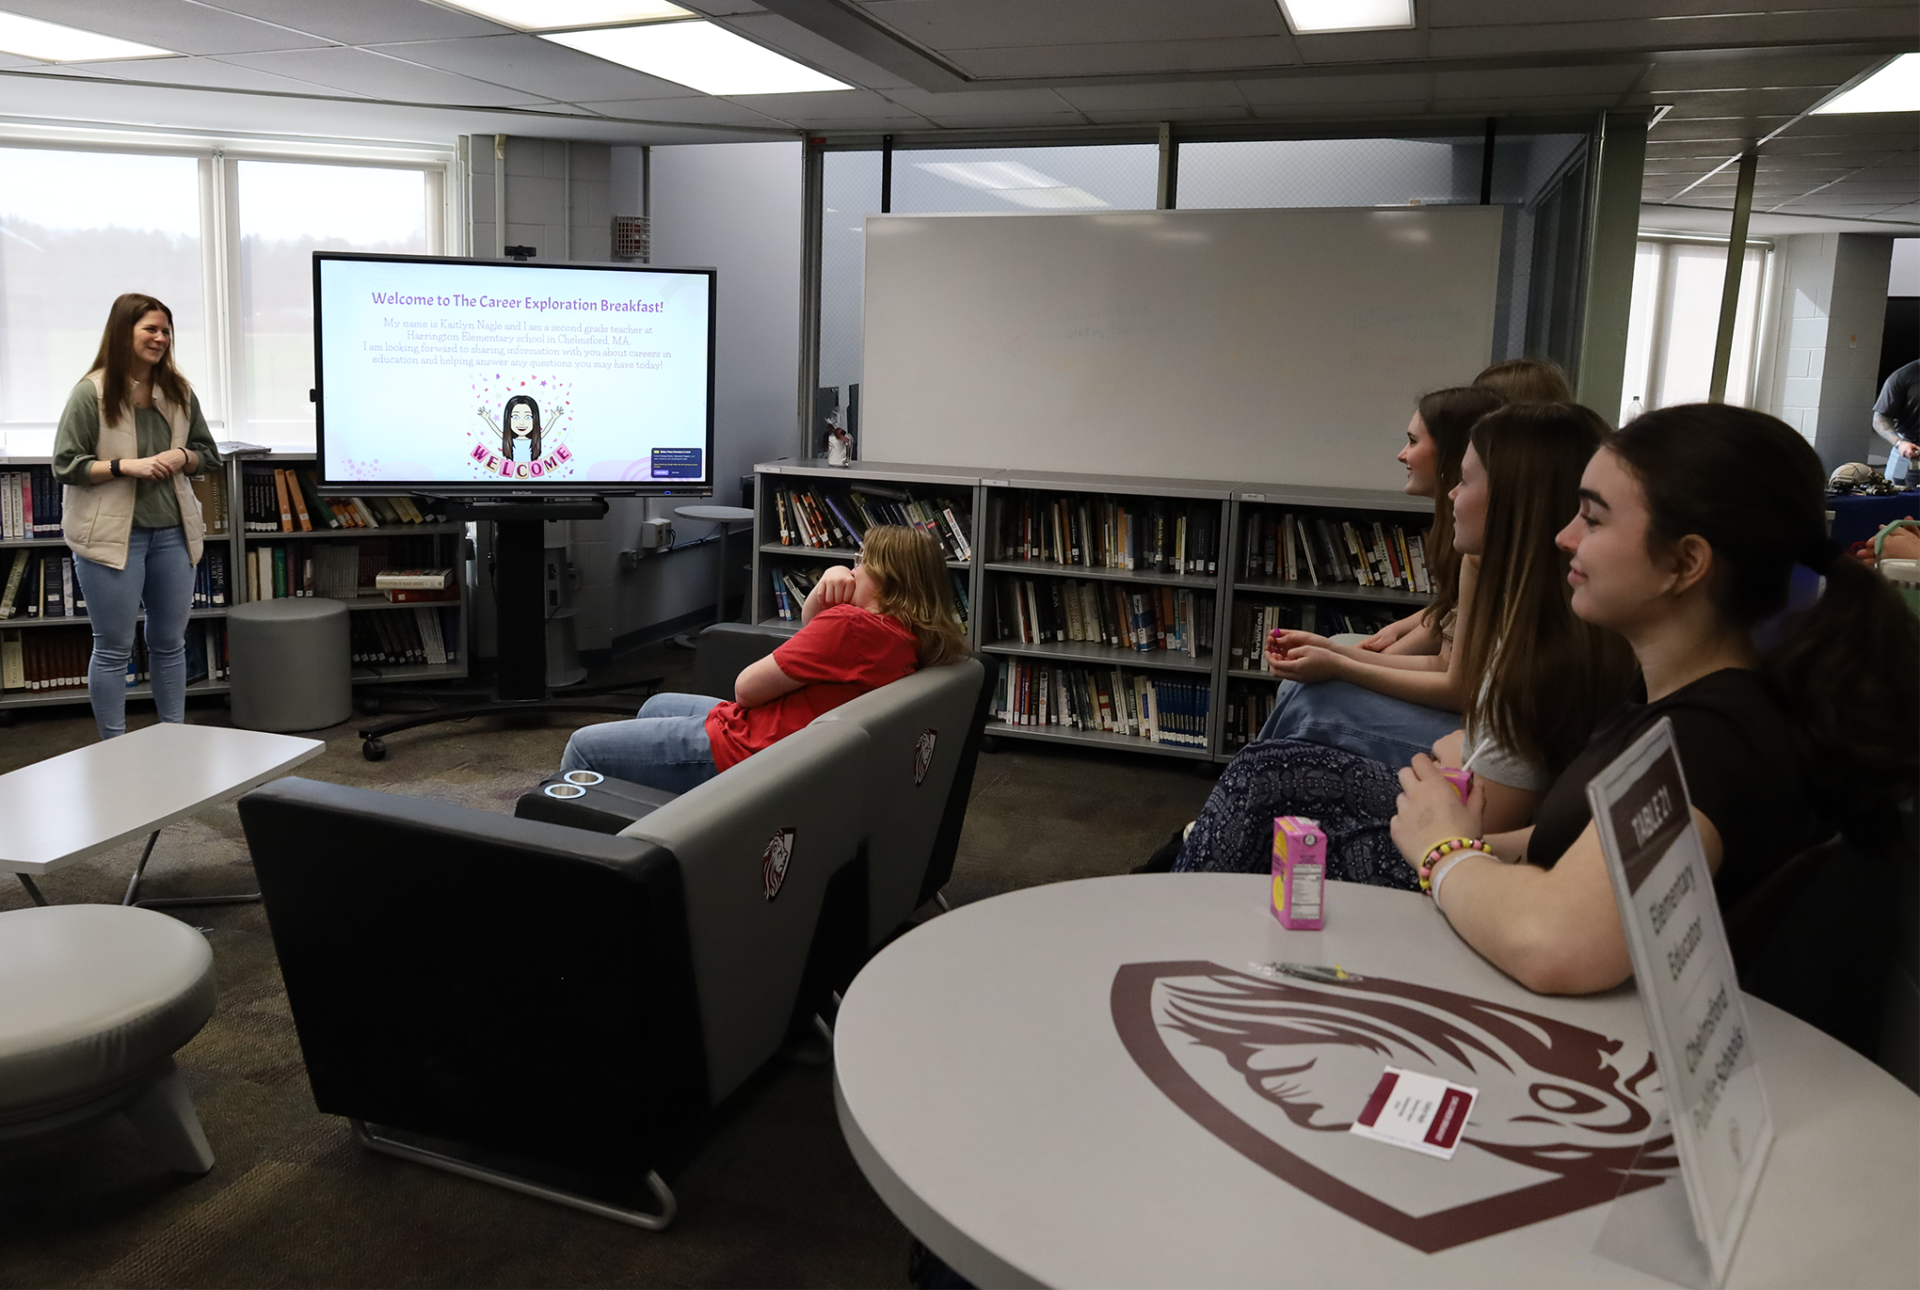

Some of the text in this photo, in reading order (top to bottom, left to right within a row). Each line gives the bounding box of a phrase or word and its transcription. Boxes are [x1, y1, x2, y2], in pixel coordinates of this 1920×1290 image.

[372, 292, 664, 313] Welcome to The Career Exploration Breakfast!
[384, 317, 400, 329] My
[430, 320, 438, 329] is
[440, 319, 474, 330] Kaitlyn
[477, 320, 502, 332] Nagle
[504, 320, 521, 331] and
[523, 321, 527, 330] I
[551, 322, 582, 332] second
[584, 324, 608, 334] grade
[610, 324, 643, 334] teacher
[407, 330, 459, 342] Harrington
[461, 331, 514, 343] Elementary
[516, 333, 545, 344] school
[547, 335, 556, 344] in
[612, 336, 632, 346] MA.
[363, 341, 366, 350] I
[385, 342, 420, 354] looking
[421, 343, 458, 353] forward
[460, 344, 469, 353] to
[471, 344, 505, 356] sharing
[507, 345, 560, 356] information
[562, 346, 581, 356] with
[584, 348, 601, 357] you
[602, 347, 626, 357] about
[629, 350, 661, 358] careers
[663, 350, 671, 358] in
[372, 354, 663, 371] education and helping answer any questions you may have today!
[473, 445, 569, 477] WELCOME
[216, 557, 224, 586] SUPREME
[1631, 796, 1663, 848] TABLE
[1649, 864, 1696, 936] Elementary
[1667, 916, 1703, 981] Educator
[1685, 982, 1728, 1074] Chelmsford
[1715, 1026, 1743, 1082] Schools
